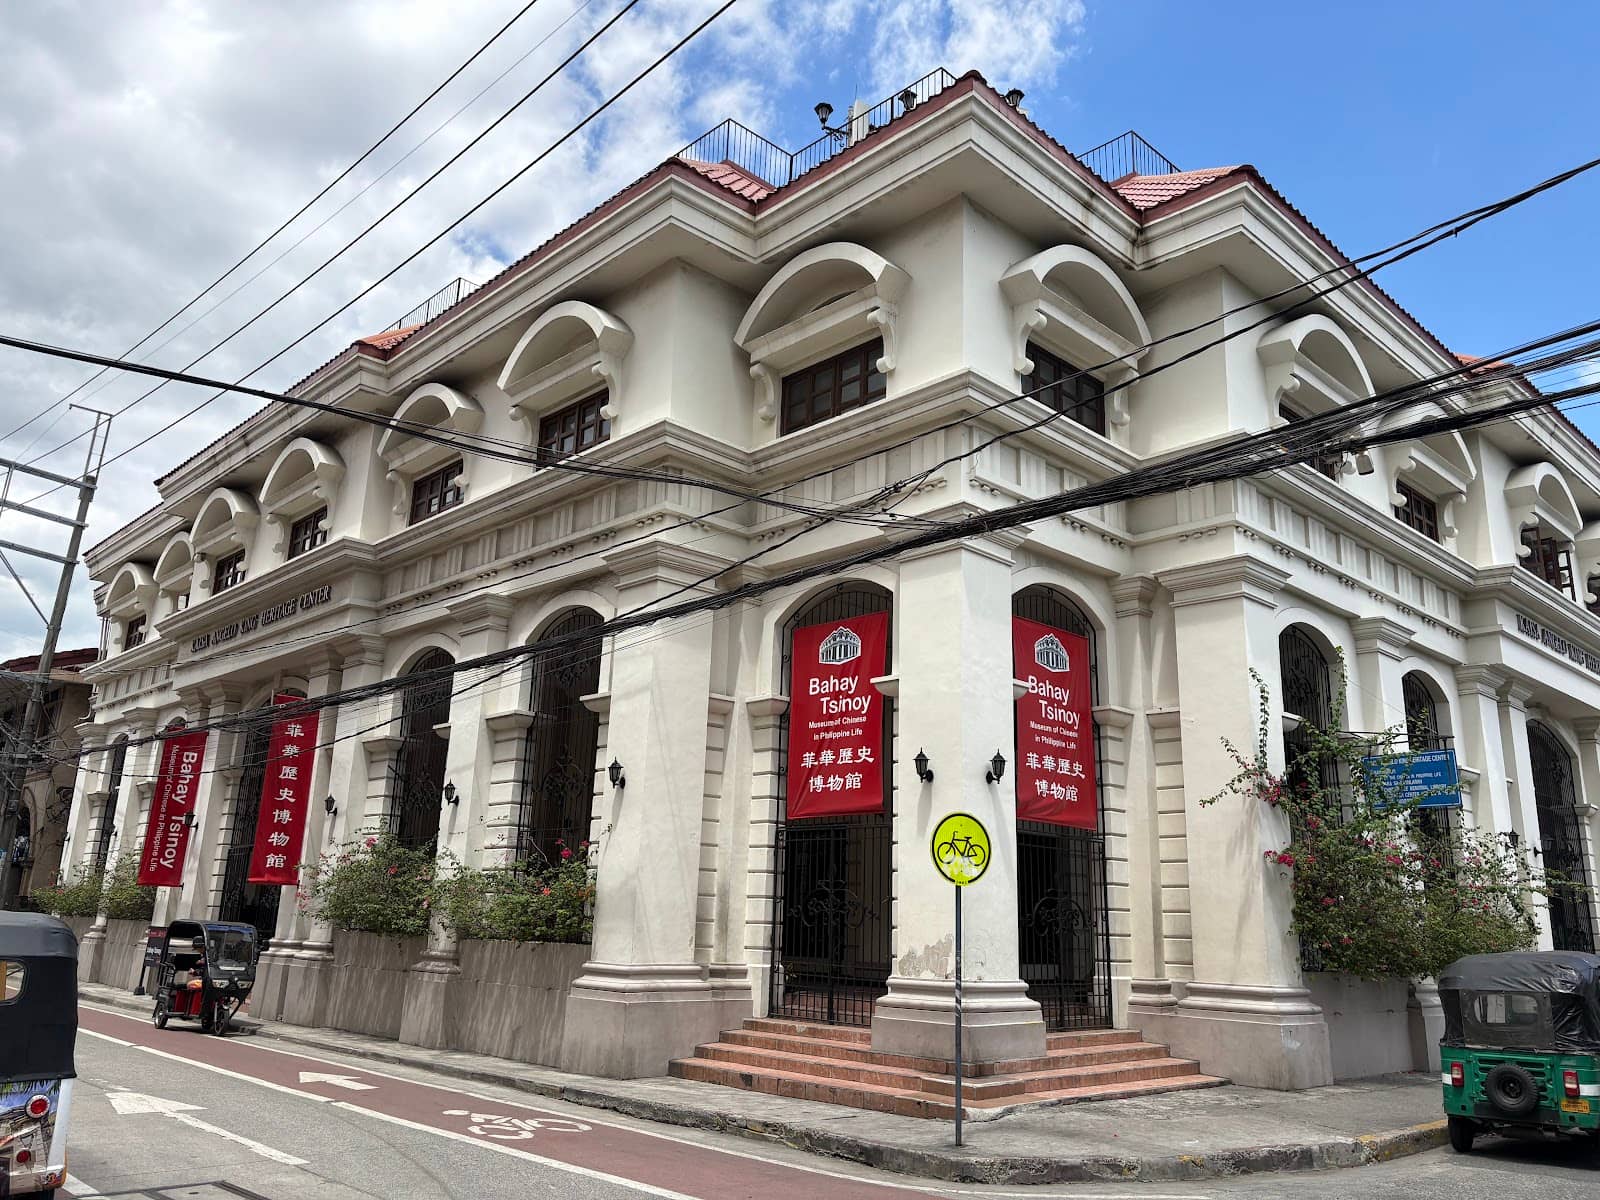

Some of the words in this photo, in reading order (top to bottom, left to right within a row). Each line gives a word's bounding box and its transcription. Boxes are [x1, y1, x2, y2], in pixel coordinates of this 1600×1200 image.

[262, 599, 298, 626] HERITAGE
[300, 585, 332, 610] CENTER
[809, 674, 859, 695] Bahay
[1028, 675, 1069, 706] Bahay
[820, 694, 872, 715] Tsinoy
[1038, 699, 1080, 730] Tsinoy
[808, 719, 834, 729] Museum
[842, 715, 867, 725] Chinese
[1029, 721, 1052, 732] Museum
[813, 733, 819, 741] in
[820, 731, 850, 740] Philippine
[851, 728, 863, 736] Life
[1041, 736, 1066, 748] Philippine
[1066, 741, 1077, 750] Life
[168, 745, 180, 773] Museum
[171, 751, 198, 805] Bahay
[809, 771, 863, 793] 博物館
[160, 783, 172, 812] Chinese
[1034, 779, 1078, 802] 博物館
[152, 822, 165, 857] Philippine
[160, 813, 187, 869] Tsinoy
[149, 857, 159, 872] Life
